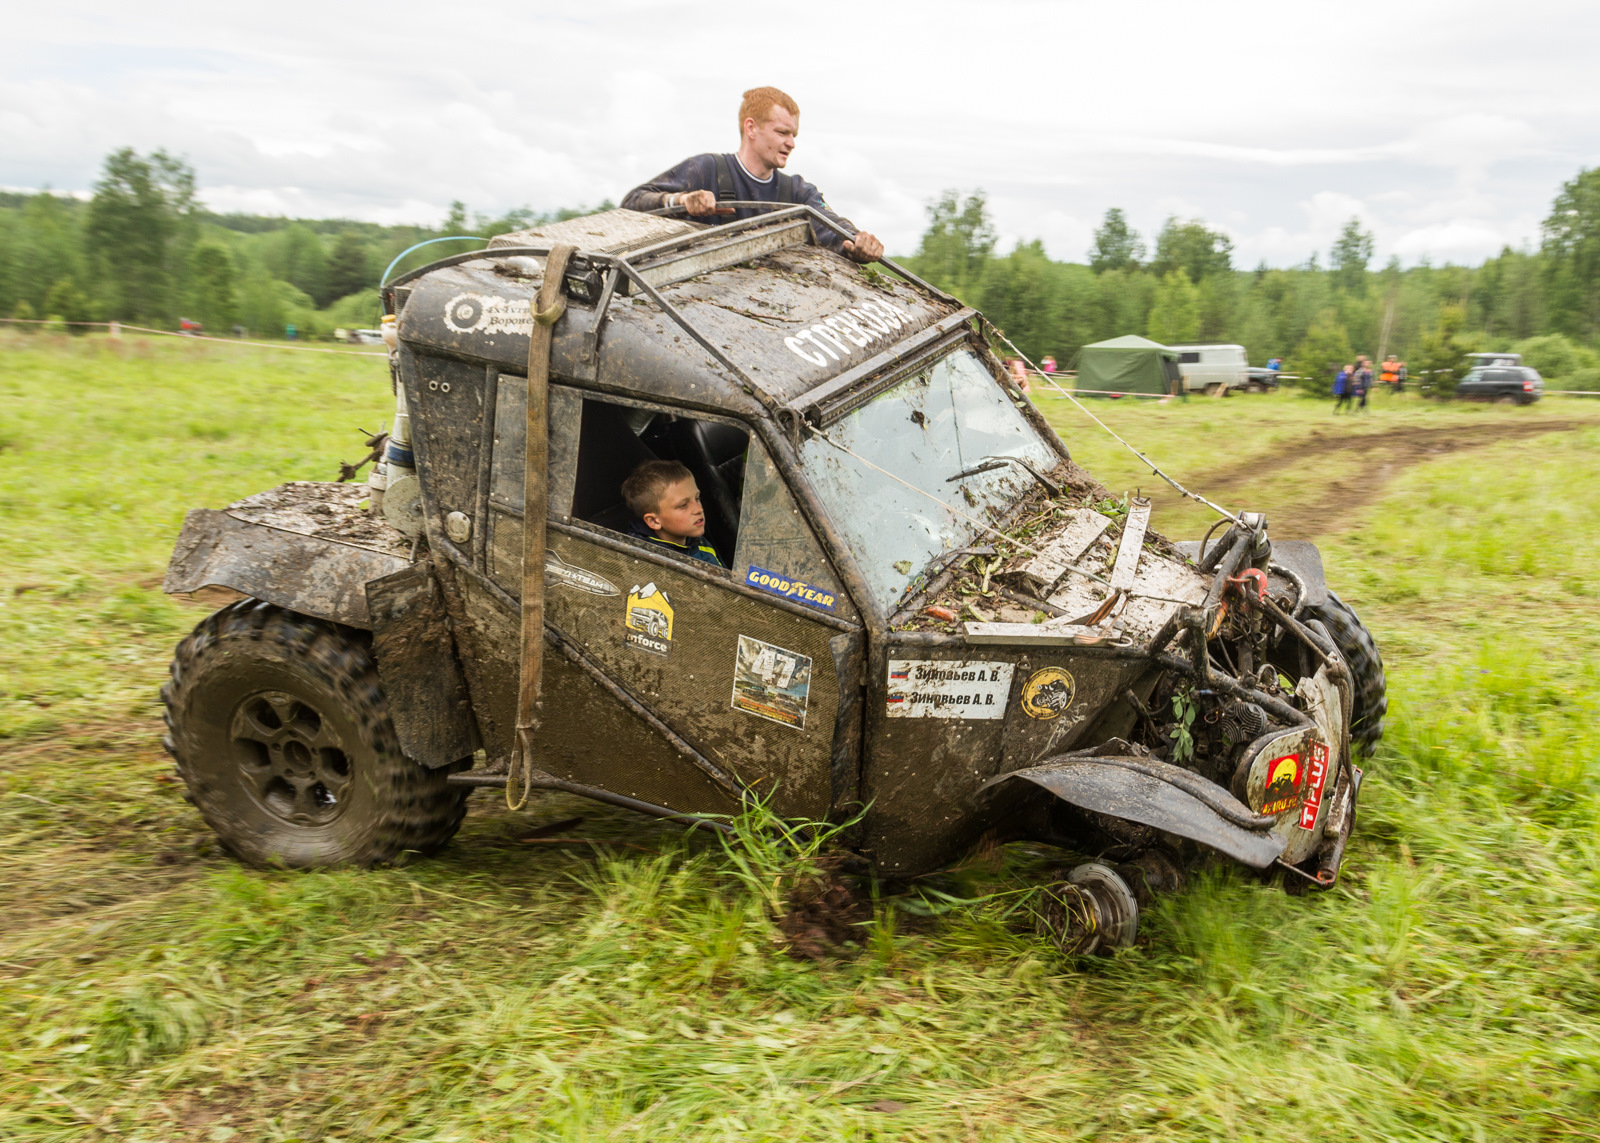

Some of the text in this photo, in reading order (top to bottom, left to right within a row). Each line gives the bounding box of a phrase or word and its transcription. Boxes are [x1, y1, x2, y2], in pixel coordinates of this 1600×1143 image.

[490, 316, 534, 327] Вороне
[783, 298, 914, 367] СТРЕКОЗА
[749, 571, 835, 607] GOODYEAR
[751, 648, 796, 689] 47
[915, 667, 1001, 682] Зиновьев А. В.
[910, 692, 996, 706] Зиновьев А. В.
